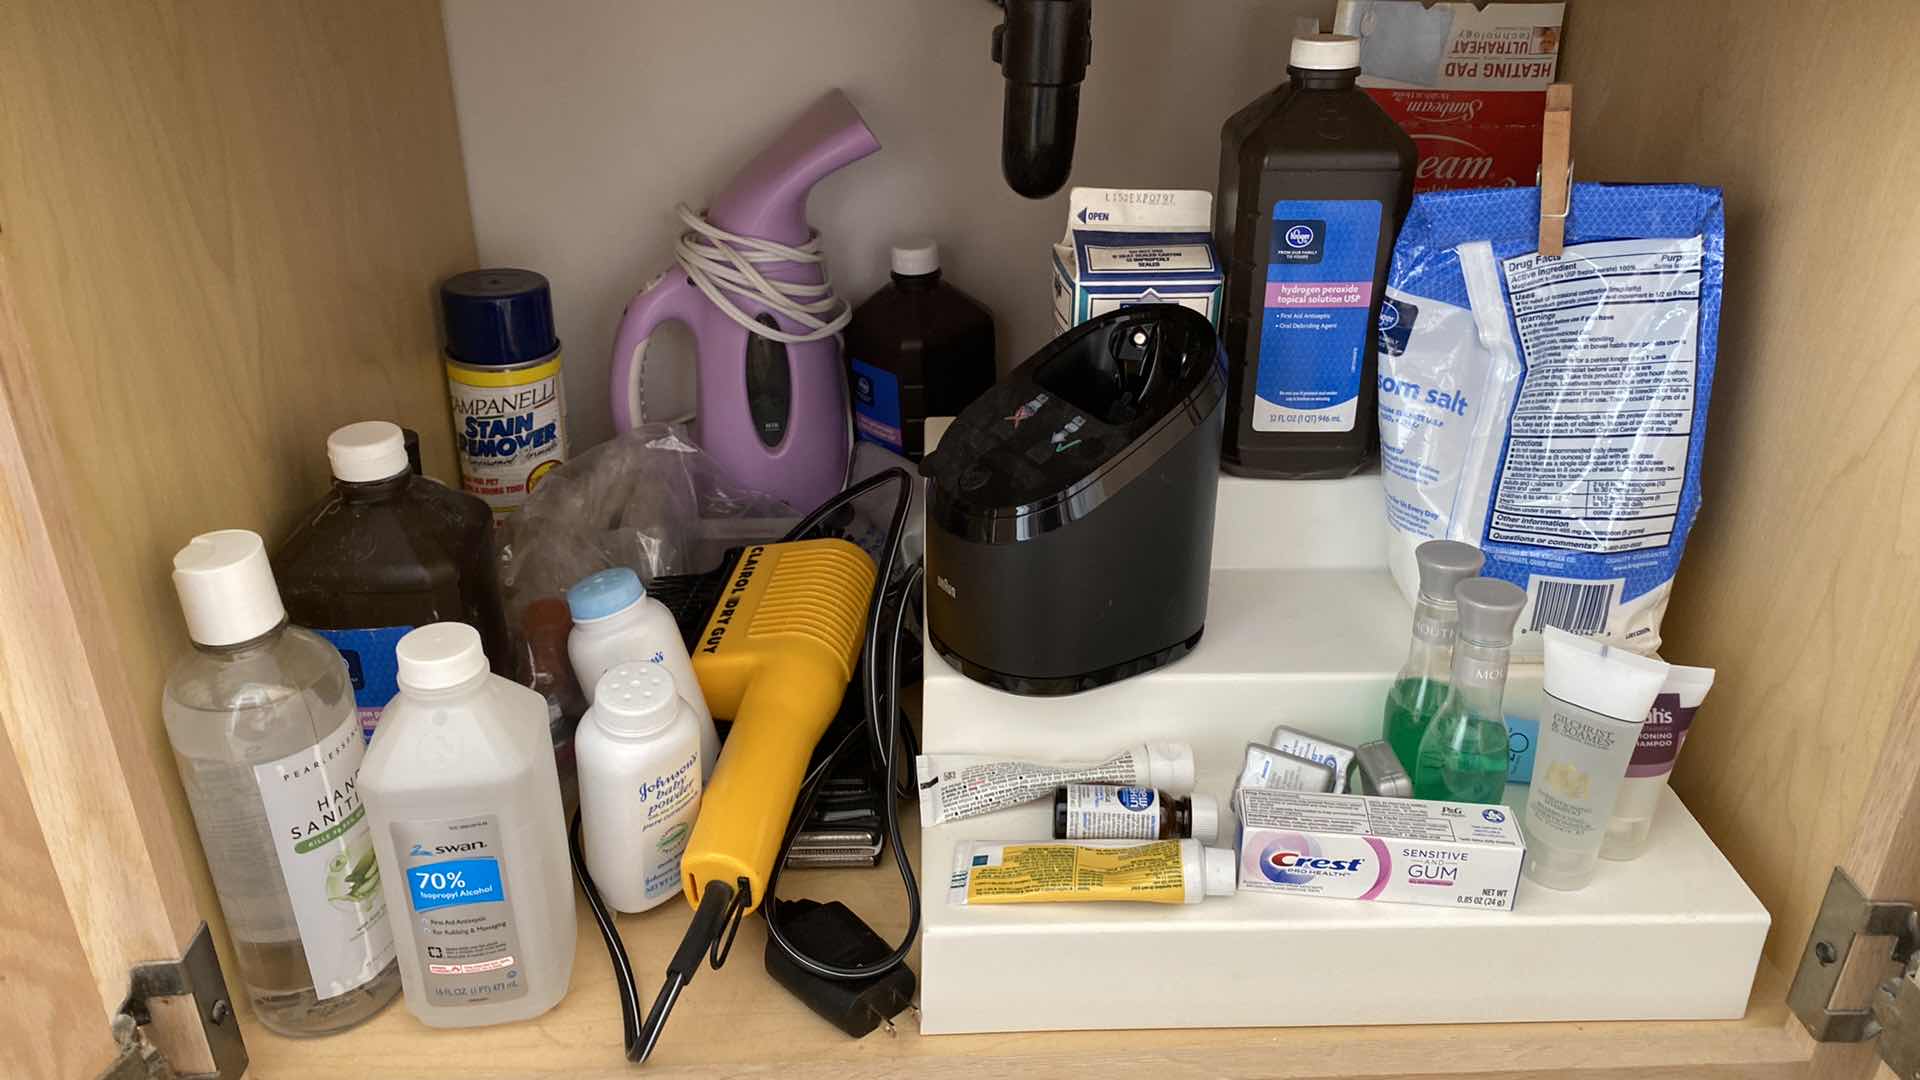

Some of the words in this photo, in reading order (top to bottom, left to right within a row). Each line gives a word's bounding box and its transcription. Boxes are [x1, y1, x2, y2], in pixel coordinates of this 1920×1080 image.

[1452, 41, 1529, 55] ULTRAHEAT
[1445, 63, 1477, 77] PAD
[1484, 63, 1552, 78] HEATING
[1407, 99, 1483, 121] Sunbeam
[1087, 212, 1109, 222] OPEN
[1508, 259, 1533, 272] Drug
[1511, 271, 1537, 284] Active
[1537, 263, 1577, 277] Ingredient
[1281, 285, 1320, 298] hydrogen
[1322, 284, 1359, 297] peroxide
[1515, 292, 1536, 301] Uses
[1277, 295, 1306, 305] topical
[1308, 294, 1342, 304] solution
[1343, 294, 1361, 303] USP
[1519, 312, 1556, 324] Warnings
[1425, 389, 1467, 416] salt
[465, 412, 534, 439] STAIN
[1304, 414, 1317, 424] QT)
[458, 422, 557, 457] REMOVER
[1512, 439, 1543, 447] Directions
[1496, 514, 1521, 524] Other
[1521, 517, 1569, 528] information
[1492, 531, 1536, 544] Questions
[1547, 537, 1599, 551] comments?
[730, 545, 765, 595] CLAIROL
[718, 596, 741, 626] DRY
[703, 626, 726, 654] GUY
[1639, 732, 1673, 741] ONING
[1402, 847, 1470, 862] SENSITIVE
[1271, 852, 1362, 872] Crest
[1308, 869, 1348, 877] HEALTH
[1407, 864, 1458, 881] GUM
[416, 871, 466, 890] 70%
[420, 890, 458, 900] Isopropyl
[460, 884, 493, 898] Alcohol
[1481, 888, 1495, 897] NET
[1496, 889, 1508, 898] WT
[1473, 896, 1483, 905] OZ
